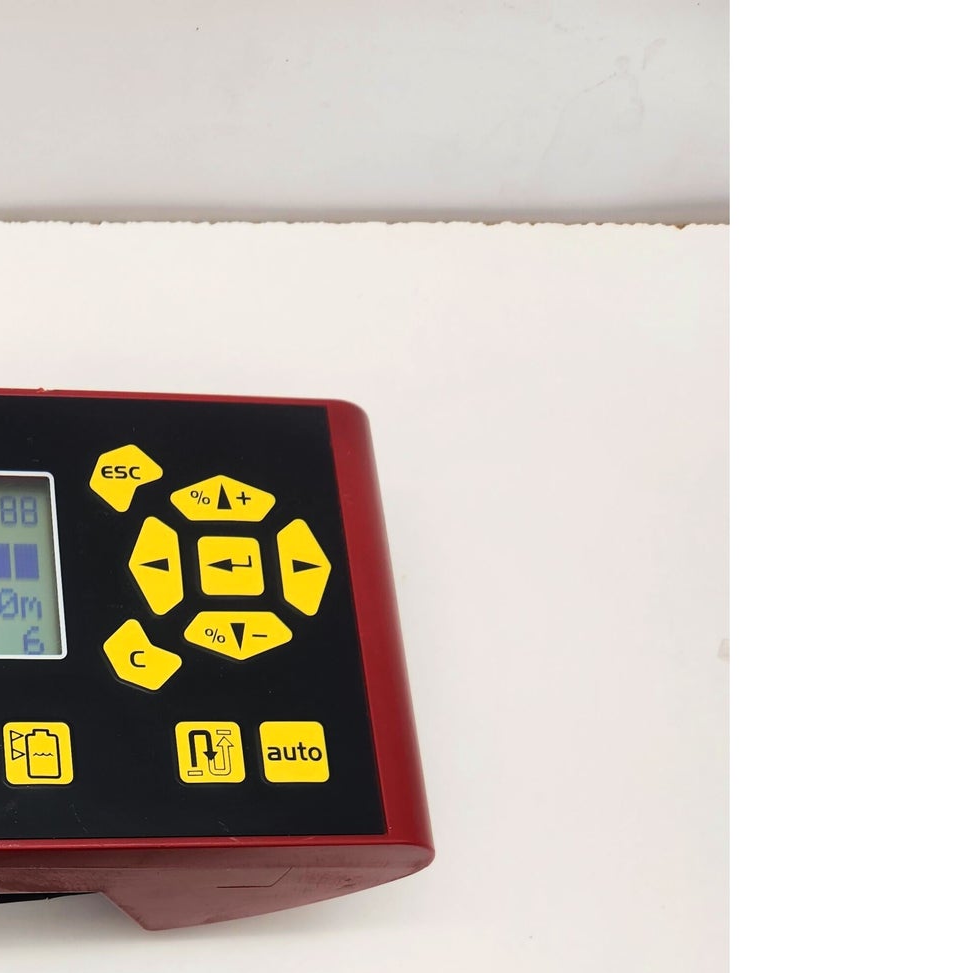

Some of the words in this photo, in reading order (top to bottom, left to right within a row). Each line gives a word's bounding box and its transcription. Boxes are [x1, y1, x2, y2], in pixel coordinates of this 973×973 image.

[100, 465, 142, 480] ESC
[0, 495, 38, 527] 88
[21, 625, 45, 655] 6
[129, 650, 146, 668] C
[267, 741, 323, 762] auto
